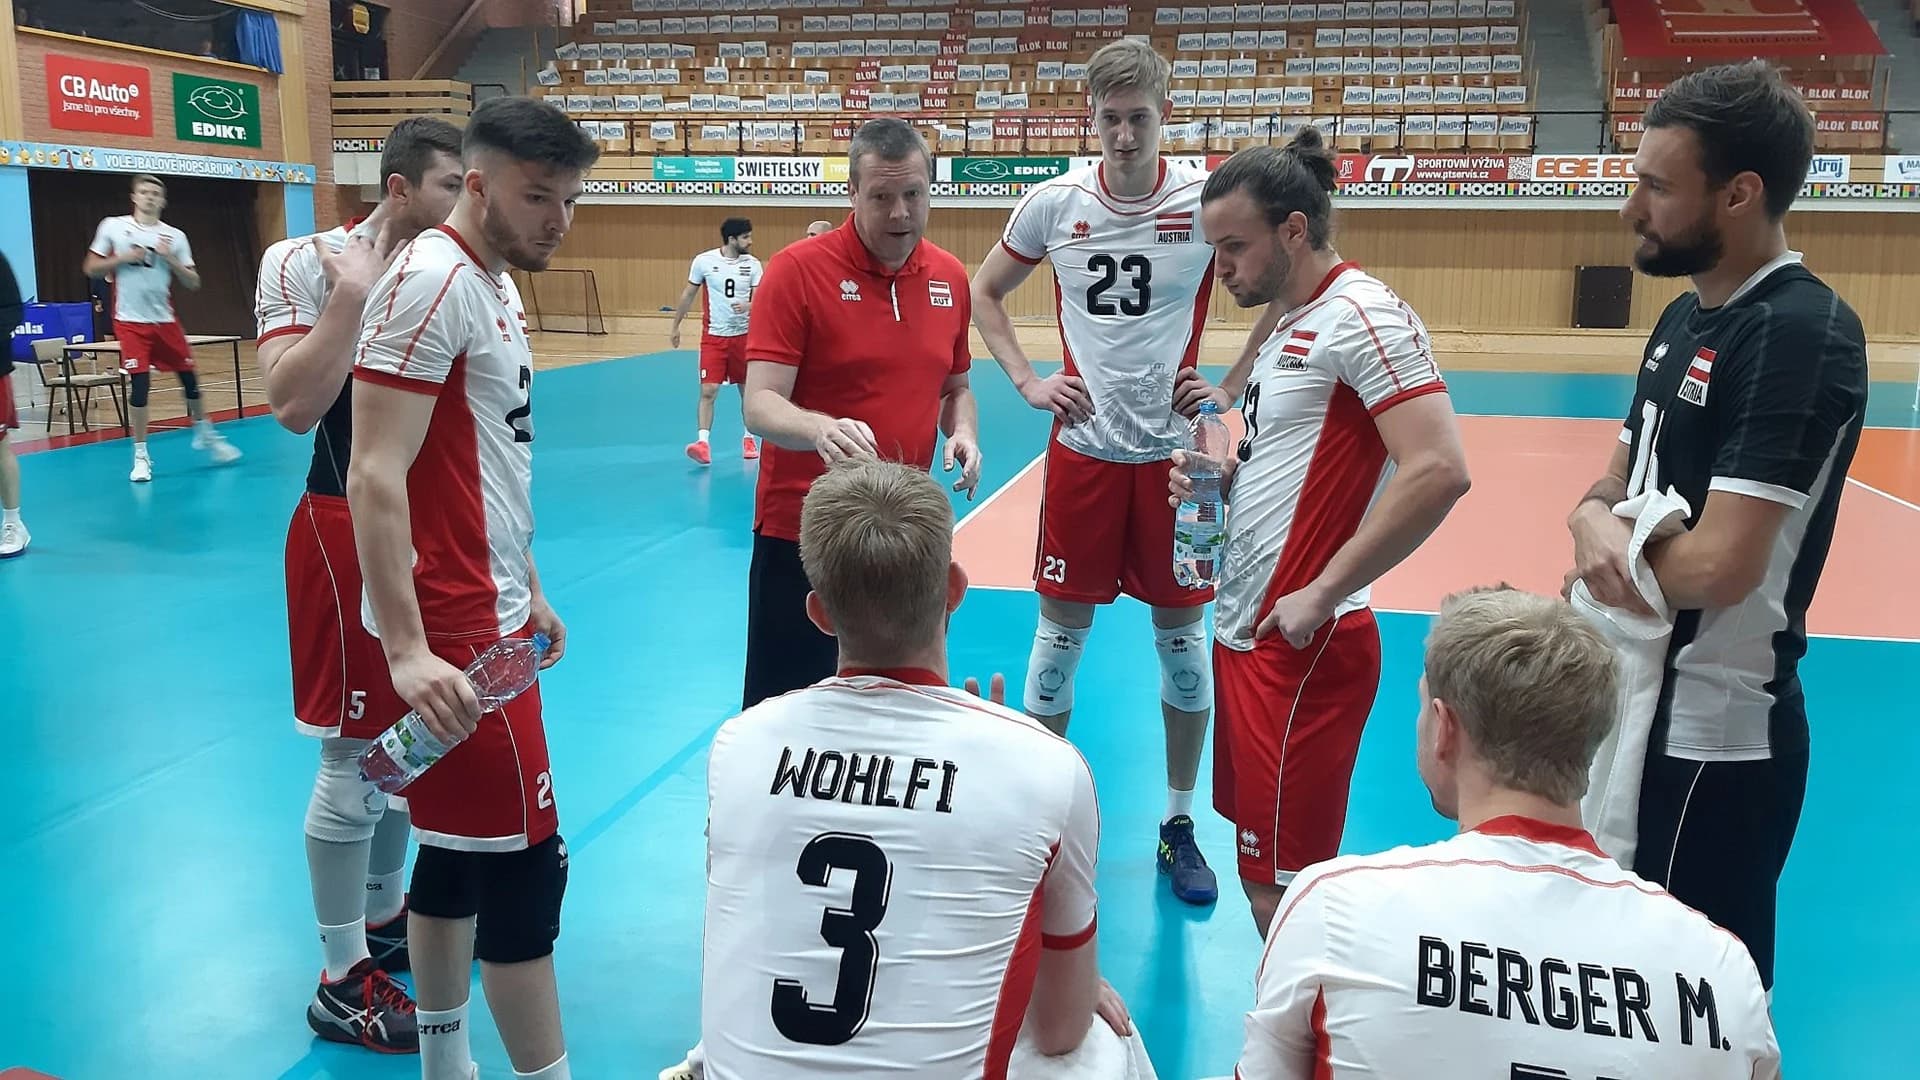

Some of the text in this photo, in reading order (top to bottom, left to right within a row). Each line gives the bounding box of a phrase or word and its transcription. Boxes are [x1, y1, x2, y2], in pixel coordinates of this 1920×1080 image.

[1027, 16, 1049, 25] BLOK
[943, 45, 964, 53] BLOK
[1019, 41, 1041, 52] BLOK
[1046, 41, 1068, 49] BLOK
[856, 71, 877, 80] BLOK
[933, 71, 955, 80] BLOK
[61, 75, 129, 103] CB Auto
[1616, 88, 1640, 97] BLOK
[1808, 89, 1836, 98] BLOK
[1841, 89, 1869, 99] BLOK
[846, 99, 867, 108] BLOK
[924, 99, 946, 107] BLOK
[95, 105, 108, 116] pro
[1618, 122, 1644, 131] BLOK
[1817, 121, 1845, 130] BLOK
[1851, 120, 1879, 130] BLOK
[833, 128, 850, 137] BLO
[996, 127, 1019, 136] BLOK
[1052, 127, 1075, 136] BLOK
[334, 140, 368, 151] HOCH
[1417, 156, 1505, 168] SPORTOVNÍ VÝŽIVA
[1536, 158, 1598, 177] EGE
[738, 162, 820, 176] SWIETELSKY
[1417, 170, 1489, 179] www.ptservis.cz
[582, 182, 618, 193] HOCH
[630, 182, 666, 193] HOCH
[676, 182, 713, 193] HOCH
[724, 183, 761, 194] HOCH
[771, 183, 810, 194] HOCH
[821, 183, 848, 195] HOC
[929, 184, 960, 195] OCH
[970, 184, 1010, 195] HOCH
[1344, 183, 1389, 195] HOCH
[1402, 183, 1447, 195] HOCH
[1460, 183, 1505, 195] HOCH
[1519, 183, 1565, 195] HOCH
[1579, 183, 1625, 195] HOCH
[1826, 184, 1874, 197] HOCH
[1158, 232, 1190, 243] AUSTRIA
[725, 278, 735, 298] 8
[1087, 254, 1152, 316] 23
[933, 297, 949, 305] AUT
[10, 322, 43, 338] ala
[1043, 556, 1066, 583] 23
[349, 691, 367, 719] 5
[770, 746, 958, 813] WOHLFI
[537, 772, 552, 810] 2
[1240, 844, 1260, 857] errea
[770, 831, 893, 1046] 3
[1417, 935, 1731, 1051] BERGER M.
